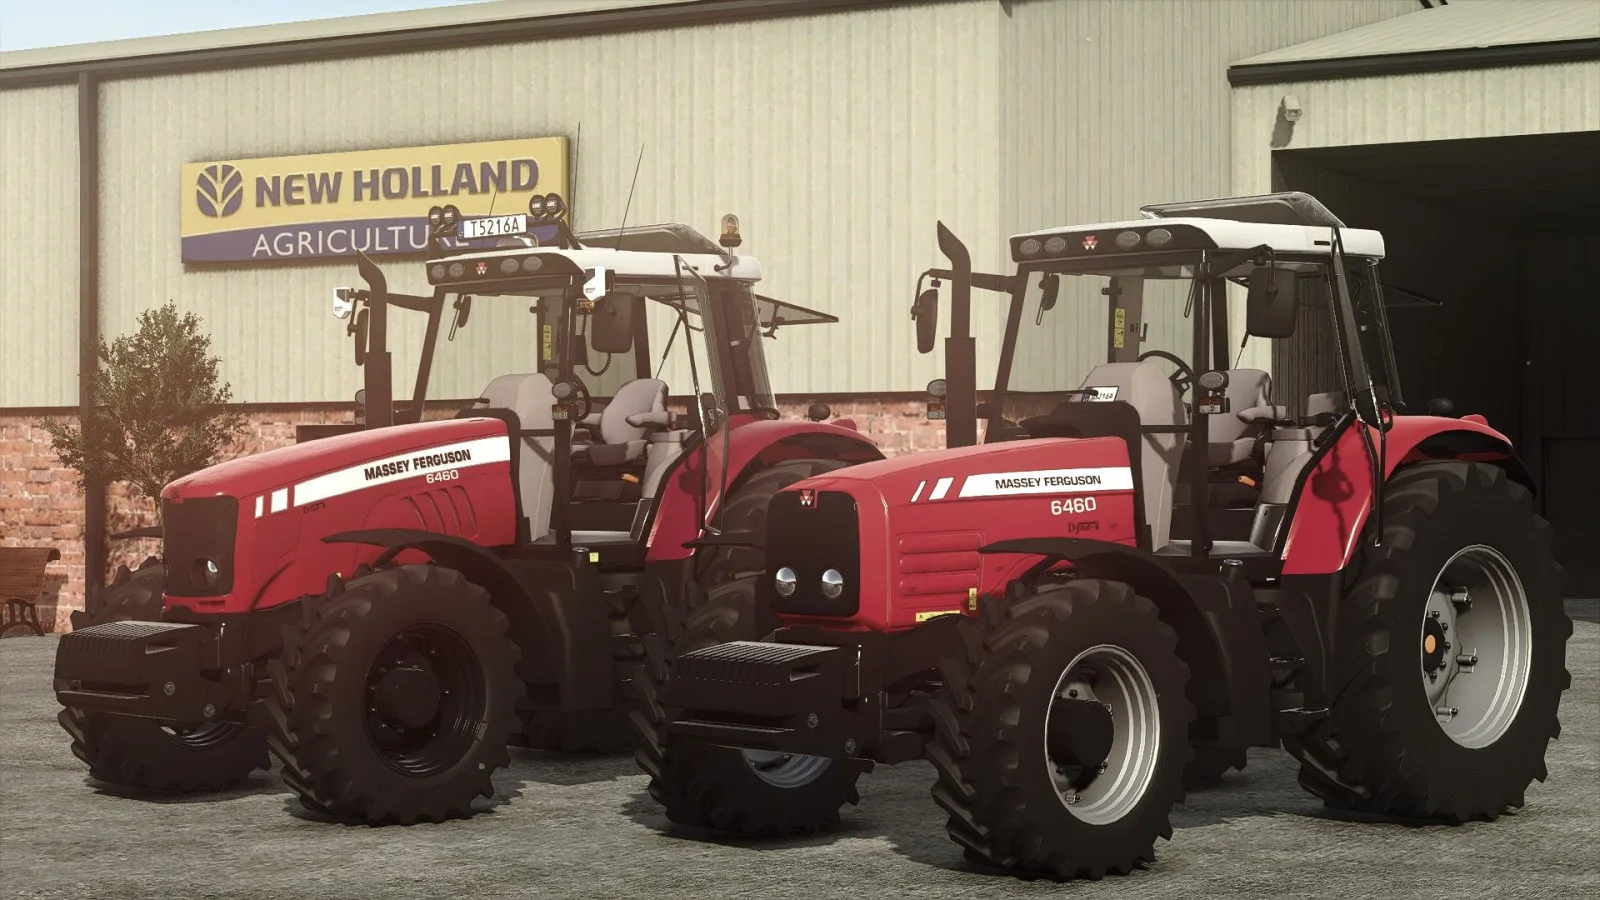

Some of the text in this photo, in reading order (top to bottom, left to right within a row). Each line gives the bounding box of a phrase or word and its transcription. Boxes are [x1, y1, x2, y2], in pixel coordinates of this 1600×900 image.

[255, 158, 539, 208] NEW HOLLAND
[471, 217, 520, 237] T5216A
[364, 448, 472, 481] MASSEY FERGUSON
[426, 469, 459, 484] 6460
[995, 475, 1102, 489] MASSEY FERGUSON
[1050, 497, 1097, 516] 6460
